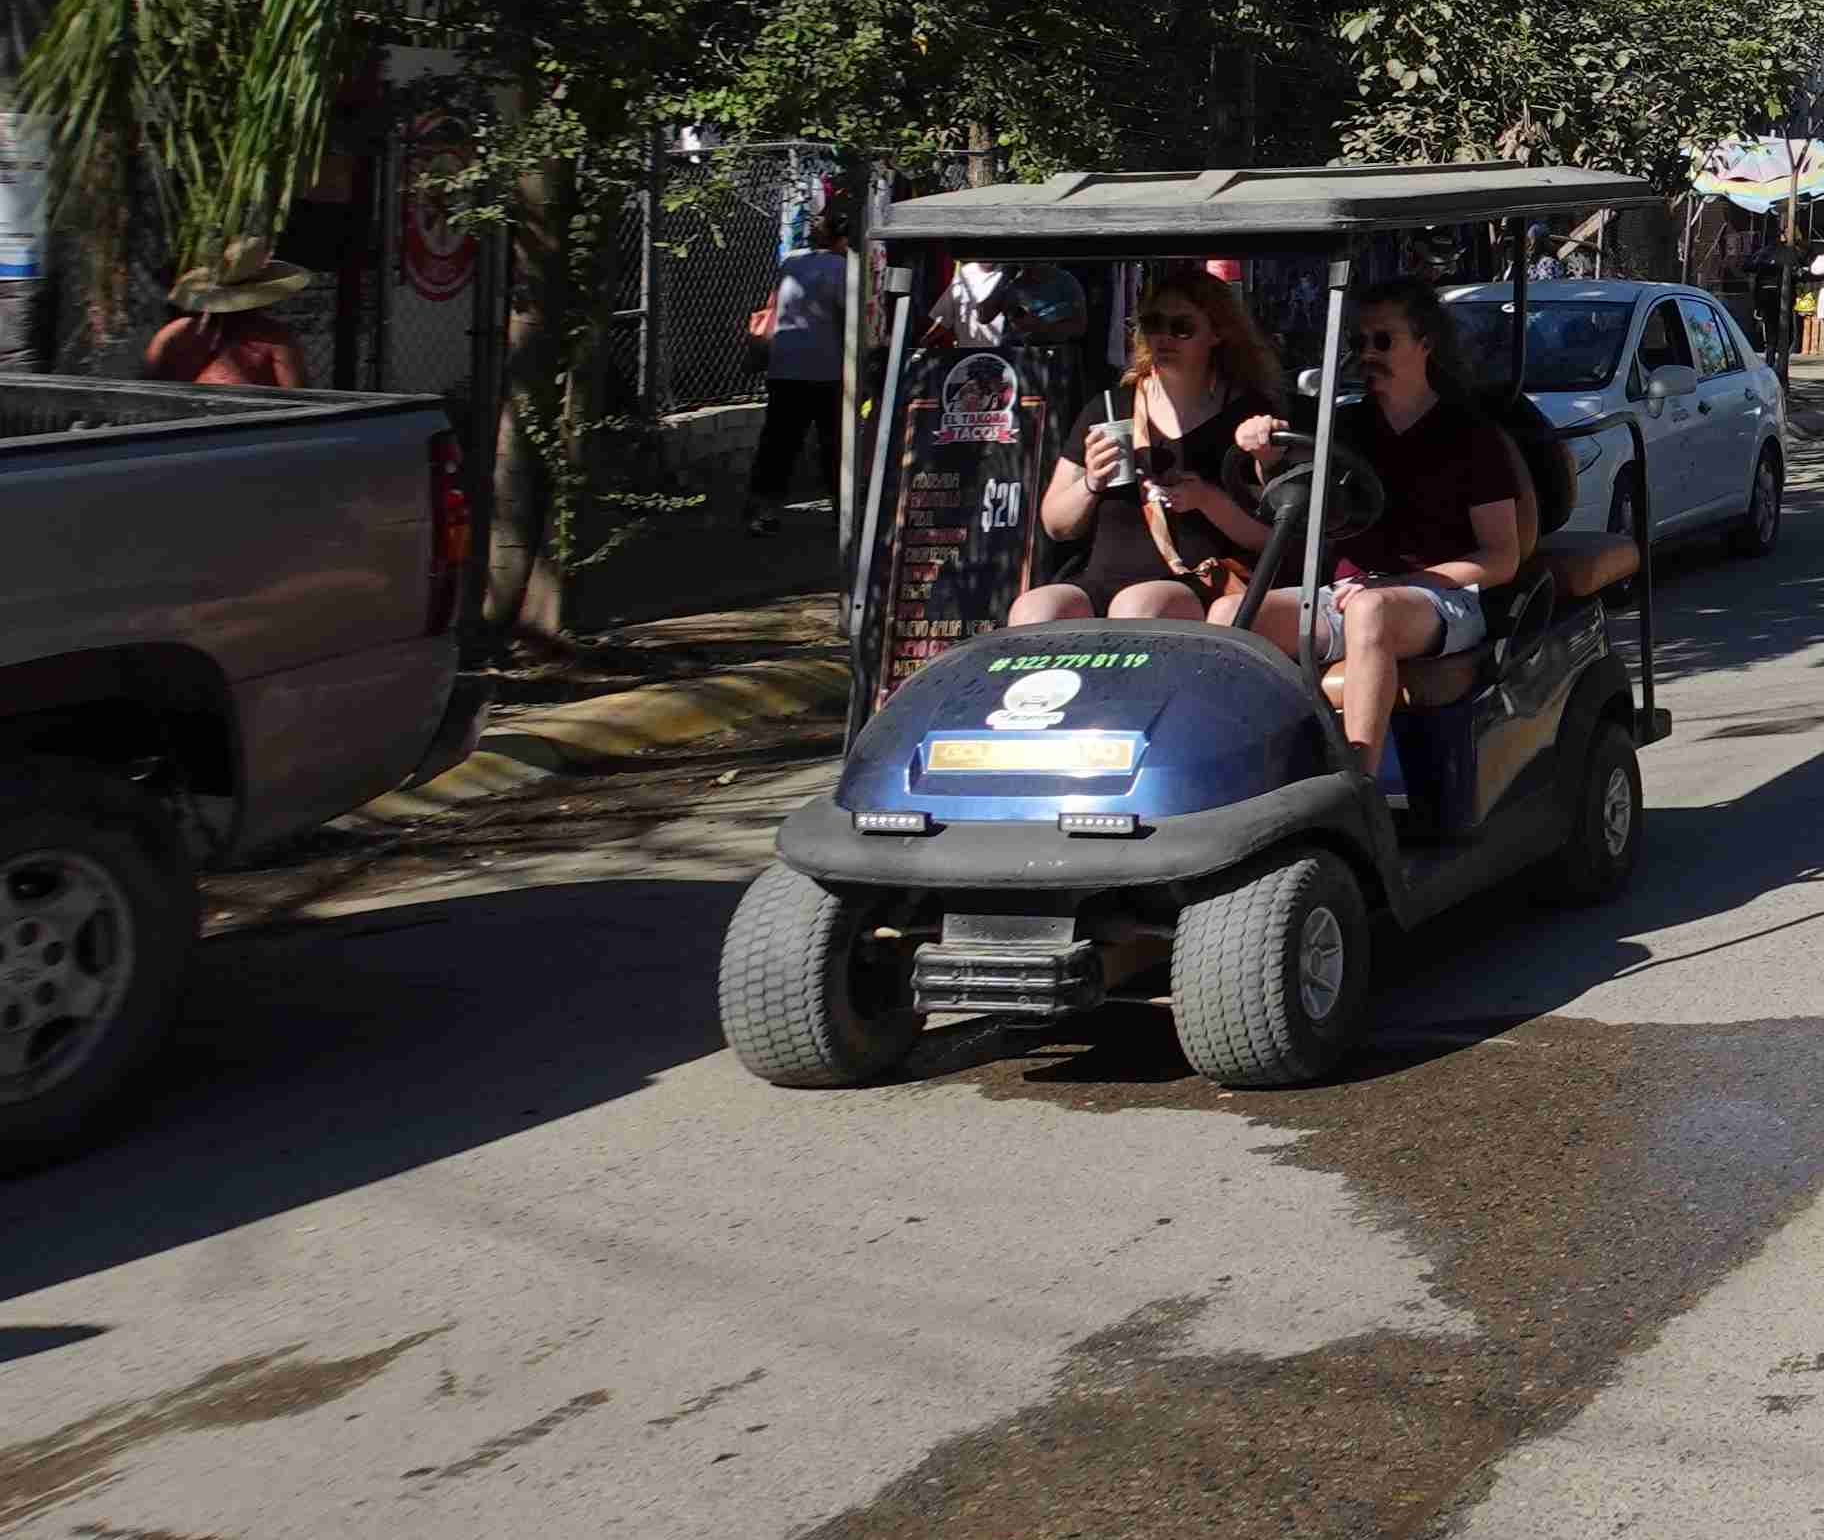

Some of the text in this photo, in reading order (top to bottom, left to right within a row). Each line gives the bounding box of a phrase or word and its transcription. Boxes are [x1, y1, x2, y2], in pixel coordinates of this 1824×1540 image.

[953, 427, 1000, 440] TACOS
[980, 478, 1023, 533] $20
[1010, 655, 1052, 670] 322
[1051, 654, 1093, 668] 779
[1091, 653, 1121, 668] 81
[1121, 652, 1149, 667] 19
